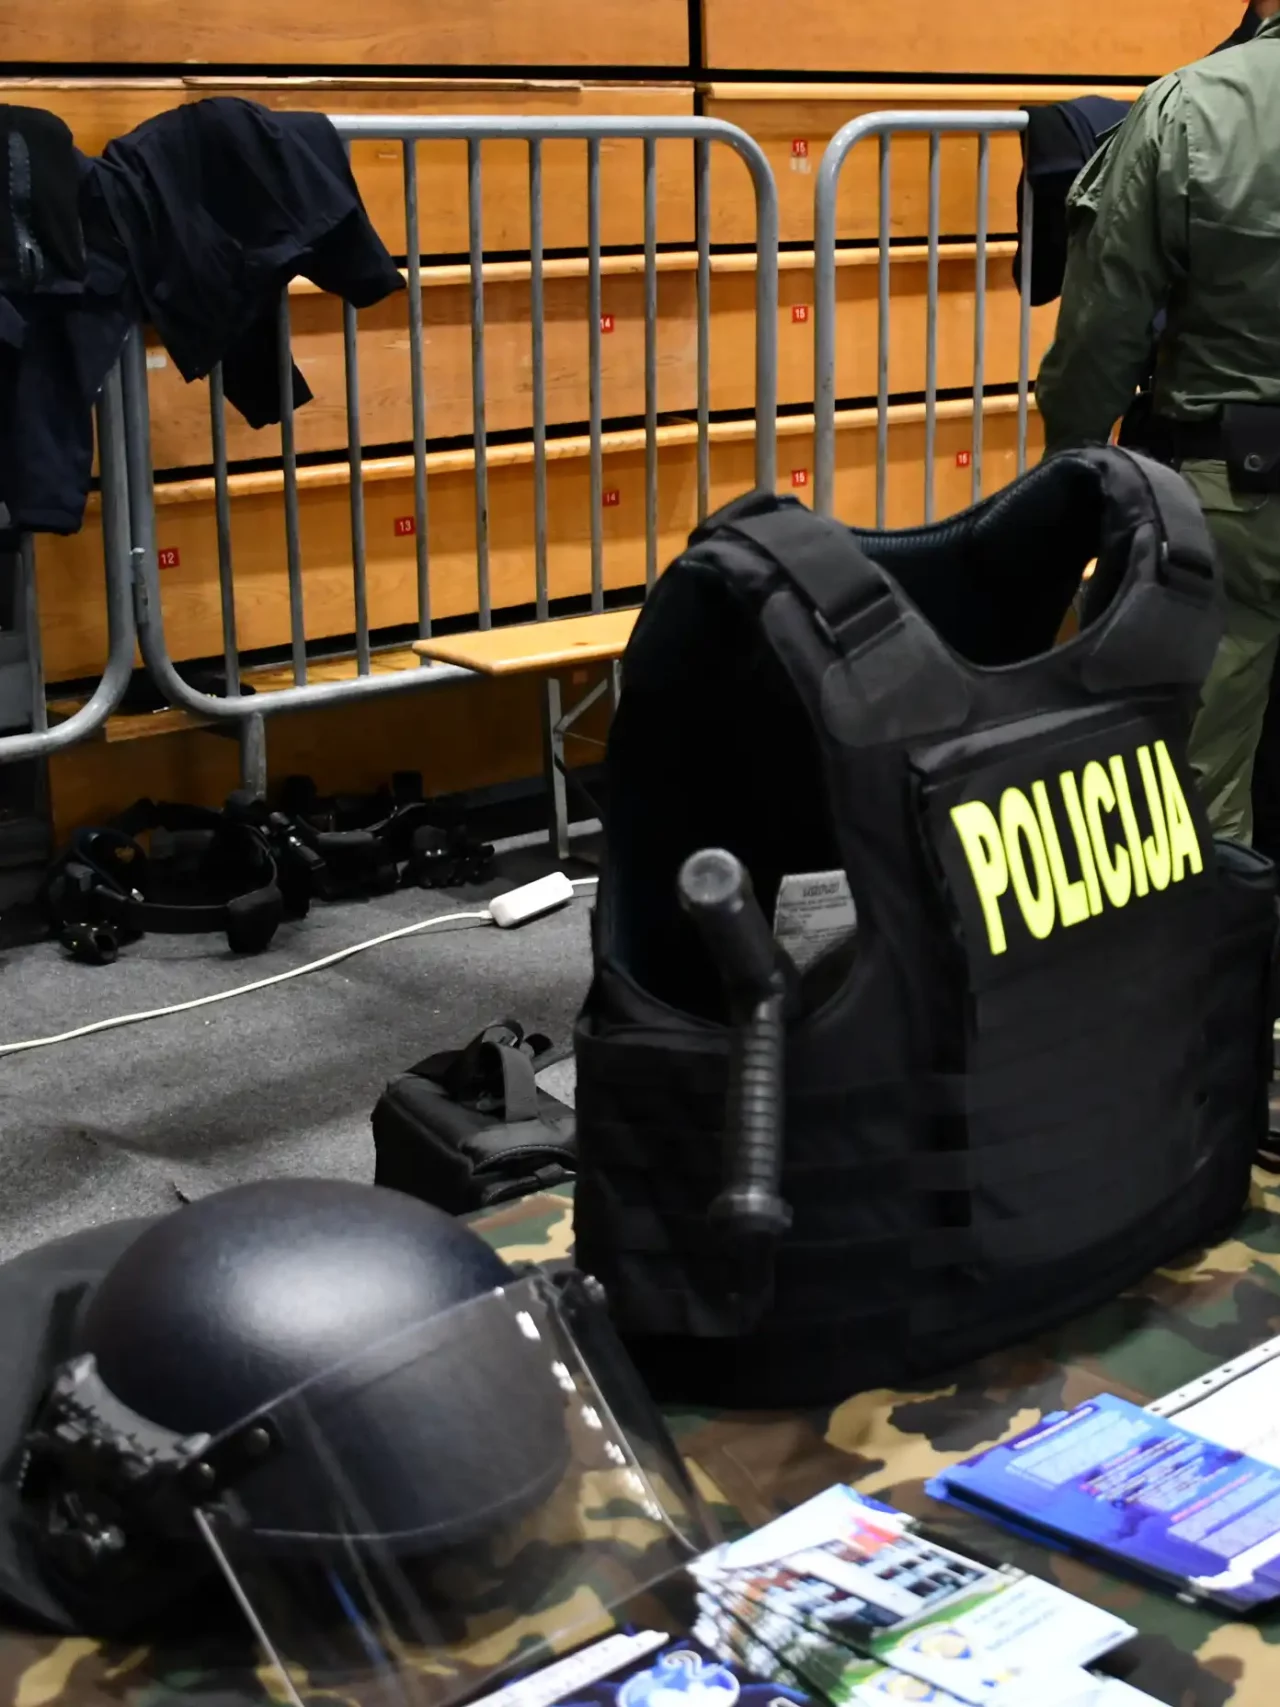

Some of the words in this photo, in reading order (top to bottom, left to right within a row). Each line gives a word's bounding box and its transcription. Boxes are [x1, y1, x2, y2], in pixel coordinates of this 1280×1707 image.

[598, 317, 612, 330] 14
[606, 492, 617, 504] 14
[399, 519, 412, 532] 13
[161, 552, 175, 565] 12
[950, 739, 1203, 956] POLICIJA
